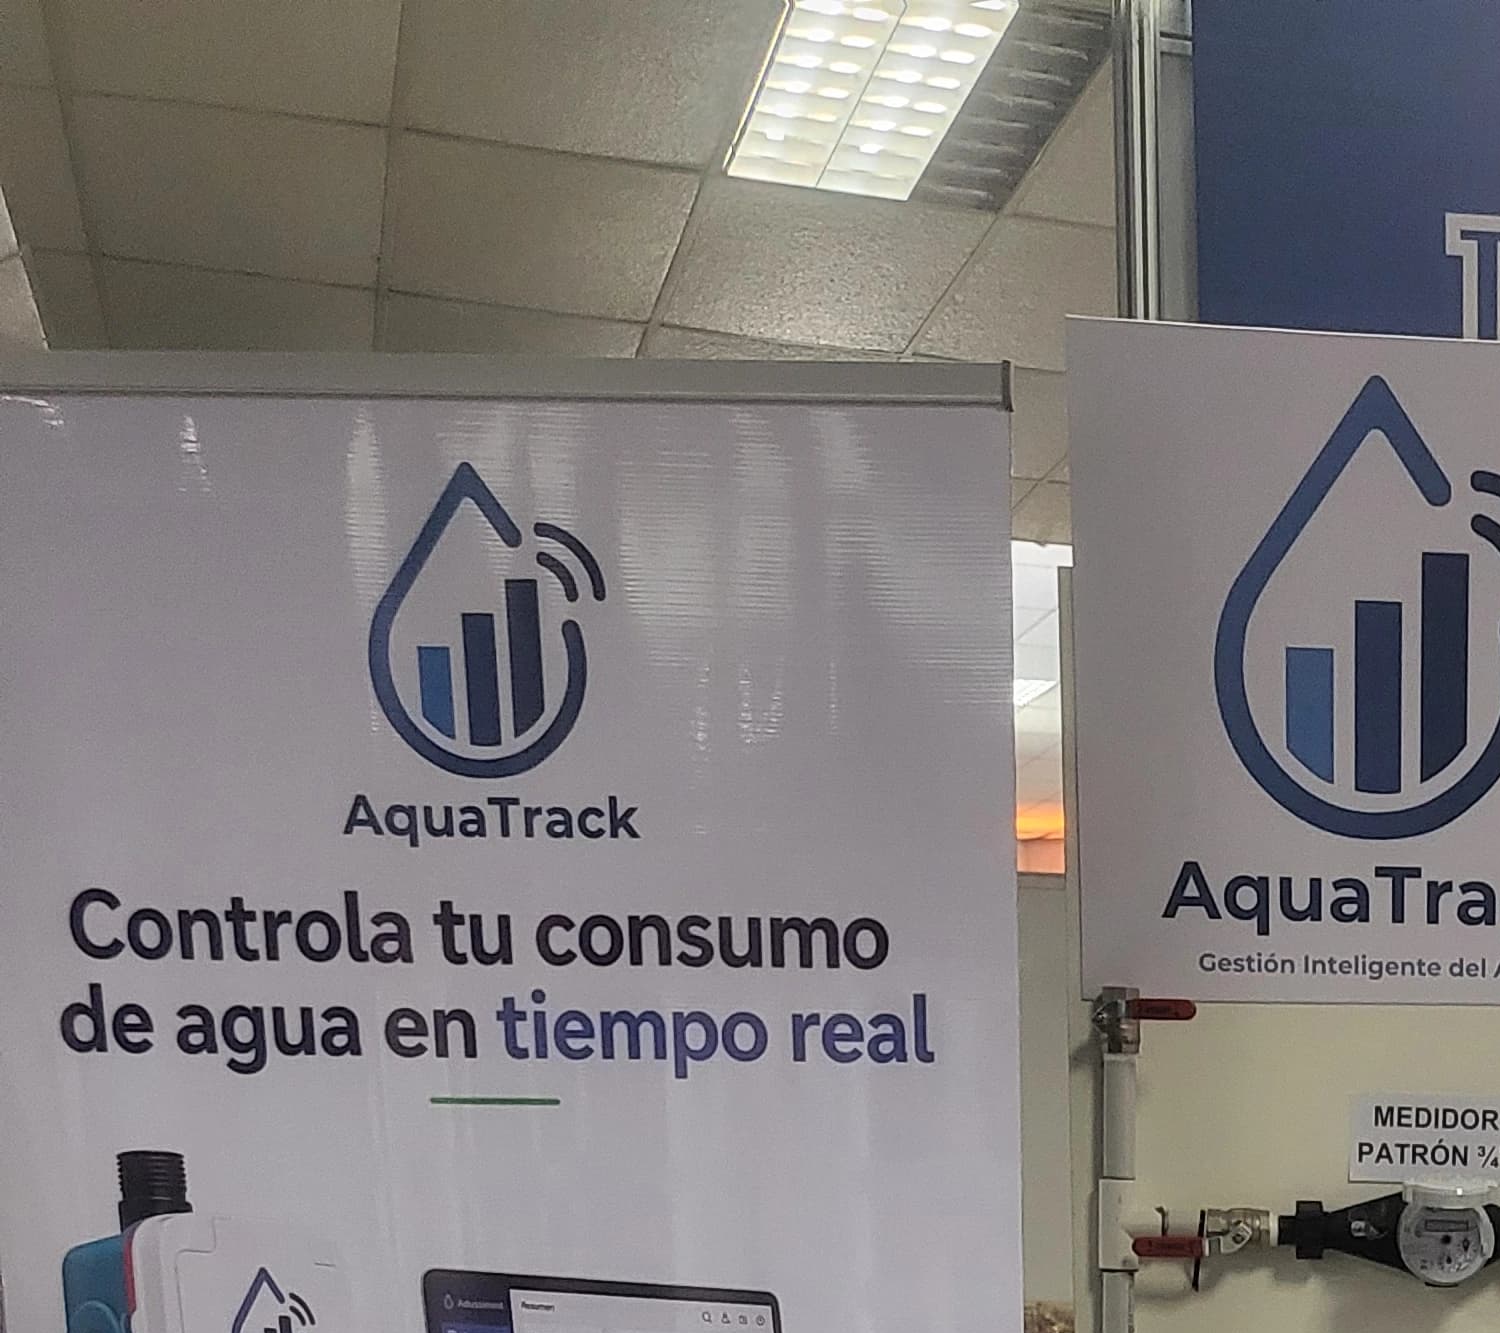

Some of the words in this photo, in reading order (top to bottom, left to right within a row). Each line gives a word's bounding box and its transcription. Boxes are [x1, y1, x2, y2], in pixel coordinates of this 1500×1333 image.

[344, 795, 640, 846] AquaTrack
[68, 888, 413, 964] Controla
[432, 898, 513, 966] tu
[535, 912, 889, 970] consumo
[1198, 952, 1295, 975] Gestión
[1303, 954, 1441, 981] Inteligente
[1449, 957, 1486, 979] del
[61, 983, 153, 1054] de
[177, 1003, 361, 1074] agua
[386, 1002, 477, 1059] en
[497, 988, 768, 1078] tiempo
[790, 994, 934, 1064] real
[1374, 1105, 1500, 1131] MEDIDOR
[1358, 1139, 1469, 1167] PATRÓN
